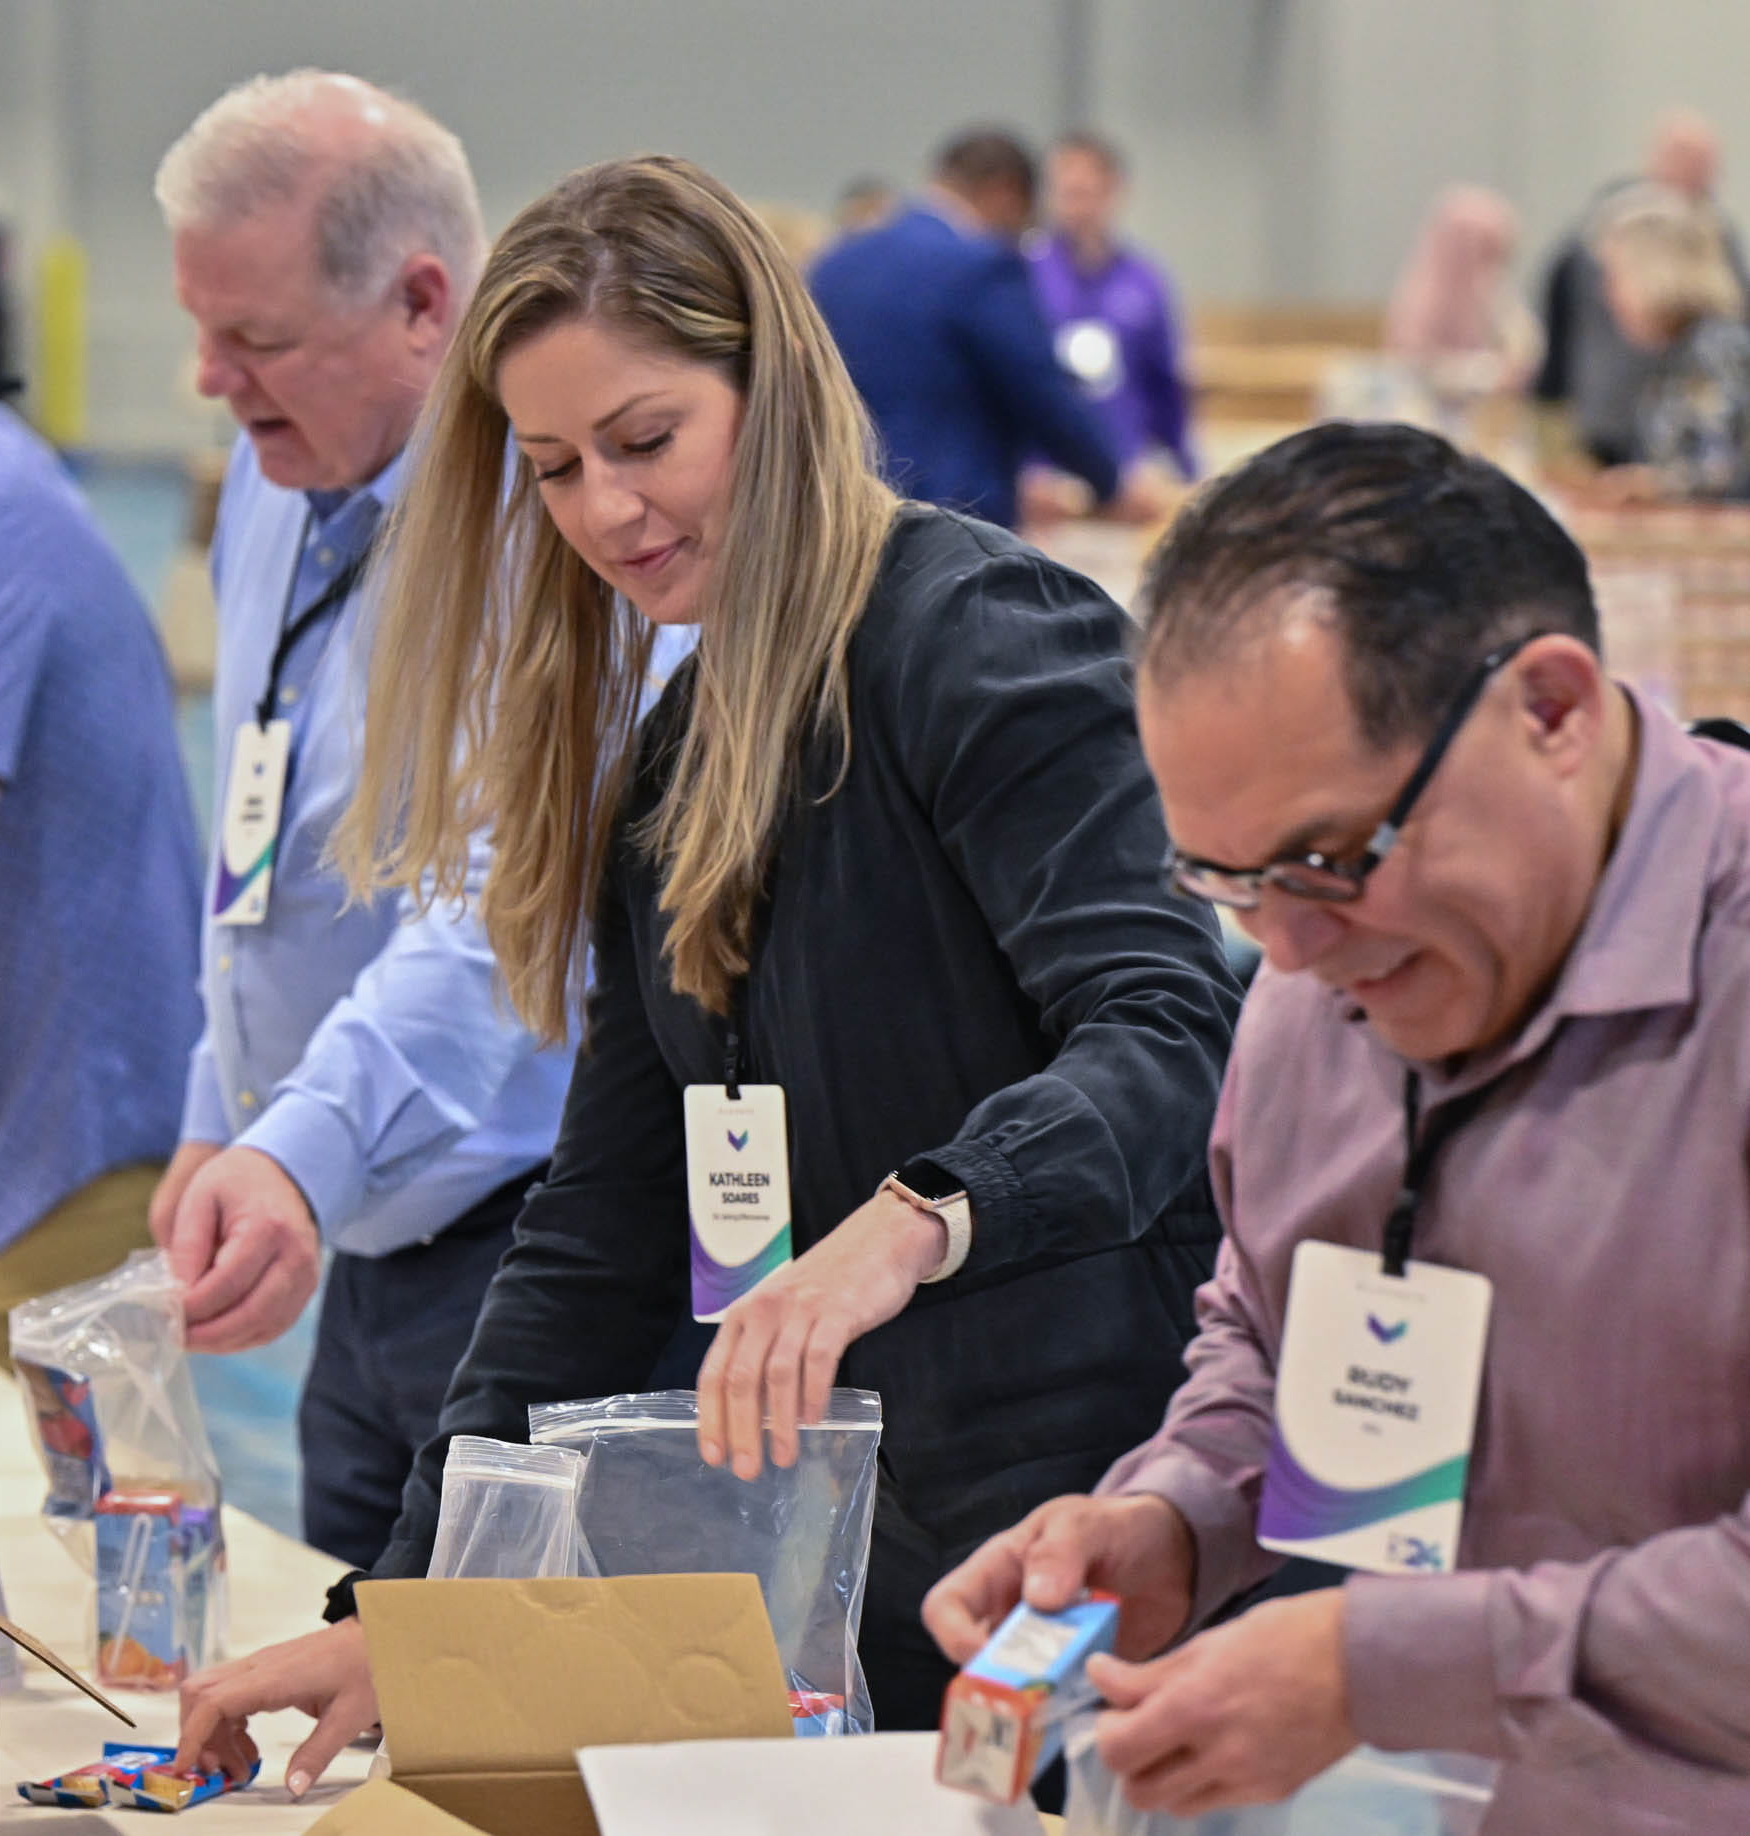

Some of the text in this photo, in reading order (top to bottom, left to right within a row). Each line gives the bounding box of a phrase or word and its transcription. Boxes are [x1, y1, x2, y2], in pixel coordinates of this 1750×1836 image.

[709, 1172, 770, 1187] KATHLEEN
[721, 1192, 759, 1204] SOARES
[1347, 1364, 1413, 1394] RUDY
[1333, 1388, 1420, 1421] SANCHEZ
